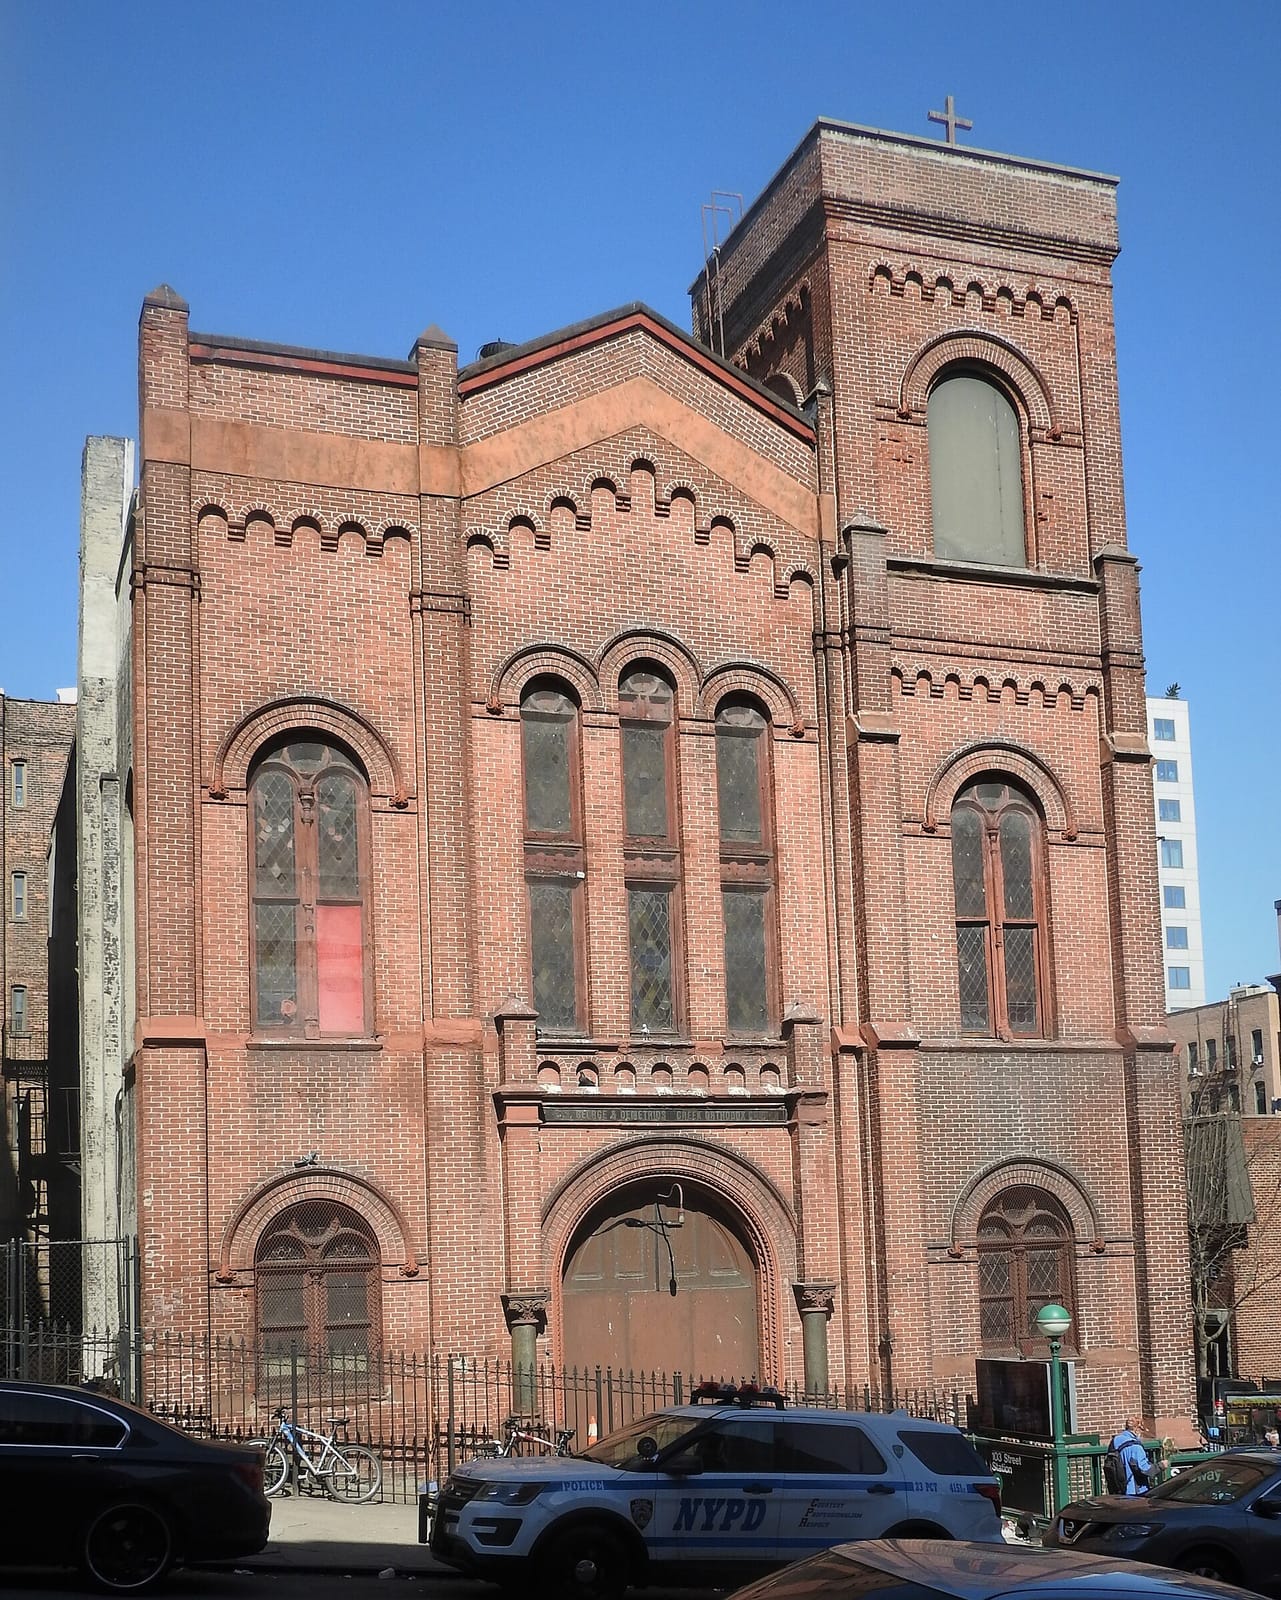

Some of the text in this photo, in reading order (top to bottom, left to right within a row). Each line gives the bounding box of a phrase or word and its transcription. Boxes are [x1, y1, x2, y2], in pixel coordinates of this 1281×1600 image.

[576, 1110, 608, 1120] GEORGE
[620, 1110, 666, 1120] DEMETRIOS
[676, 1110, 700, 1121] GREEK
[705, 1110, 746, 1121] ORTHODOX
[991, 1452, 1022, 1466] 103 Street
[991, 1461, 1013, 1474] Station
[561, 1480, 605, 1492] POLICE
[925, 1482, 938, 1493] PCT
[672, 1498, 767, 1531] NYPD
